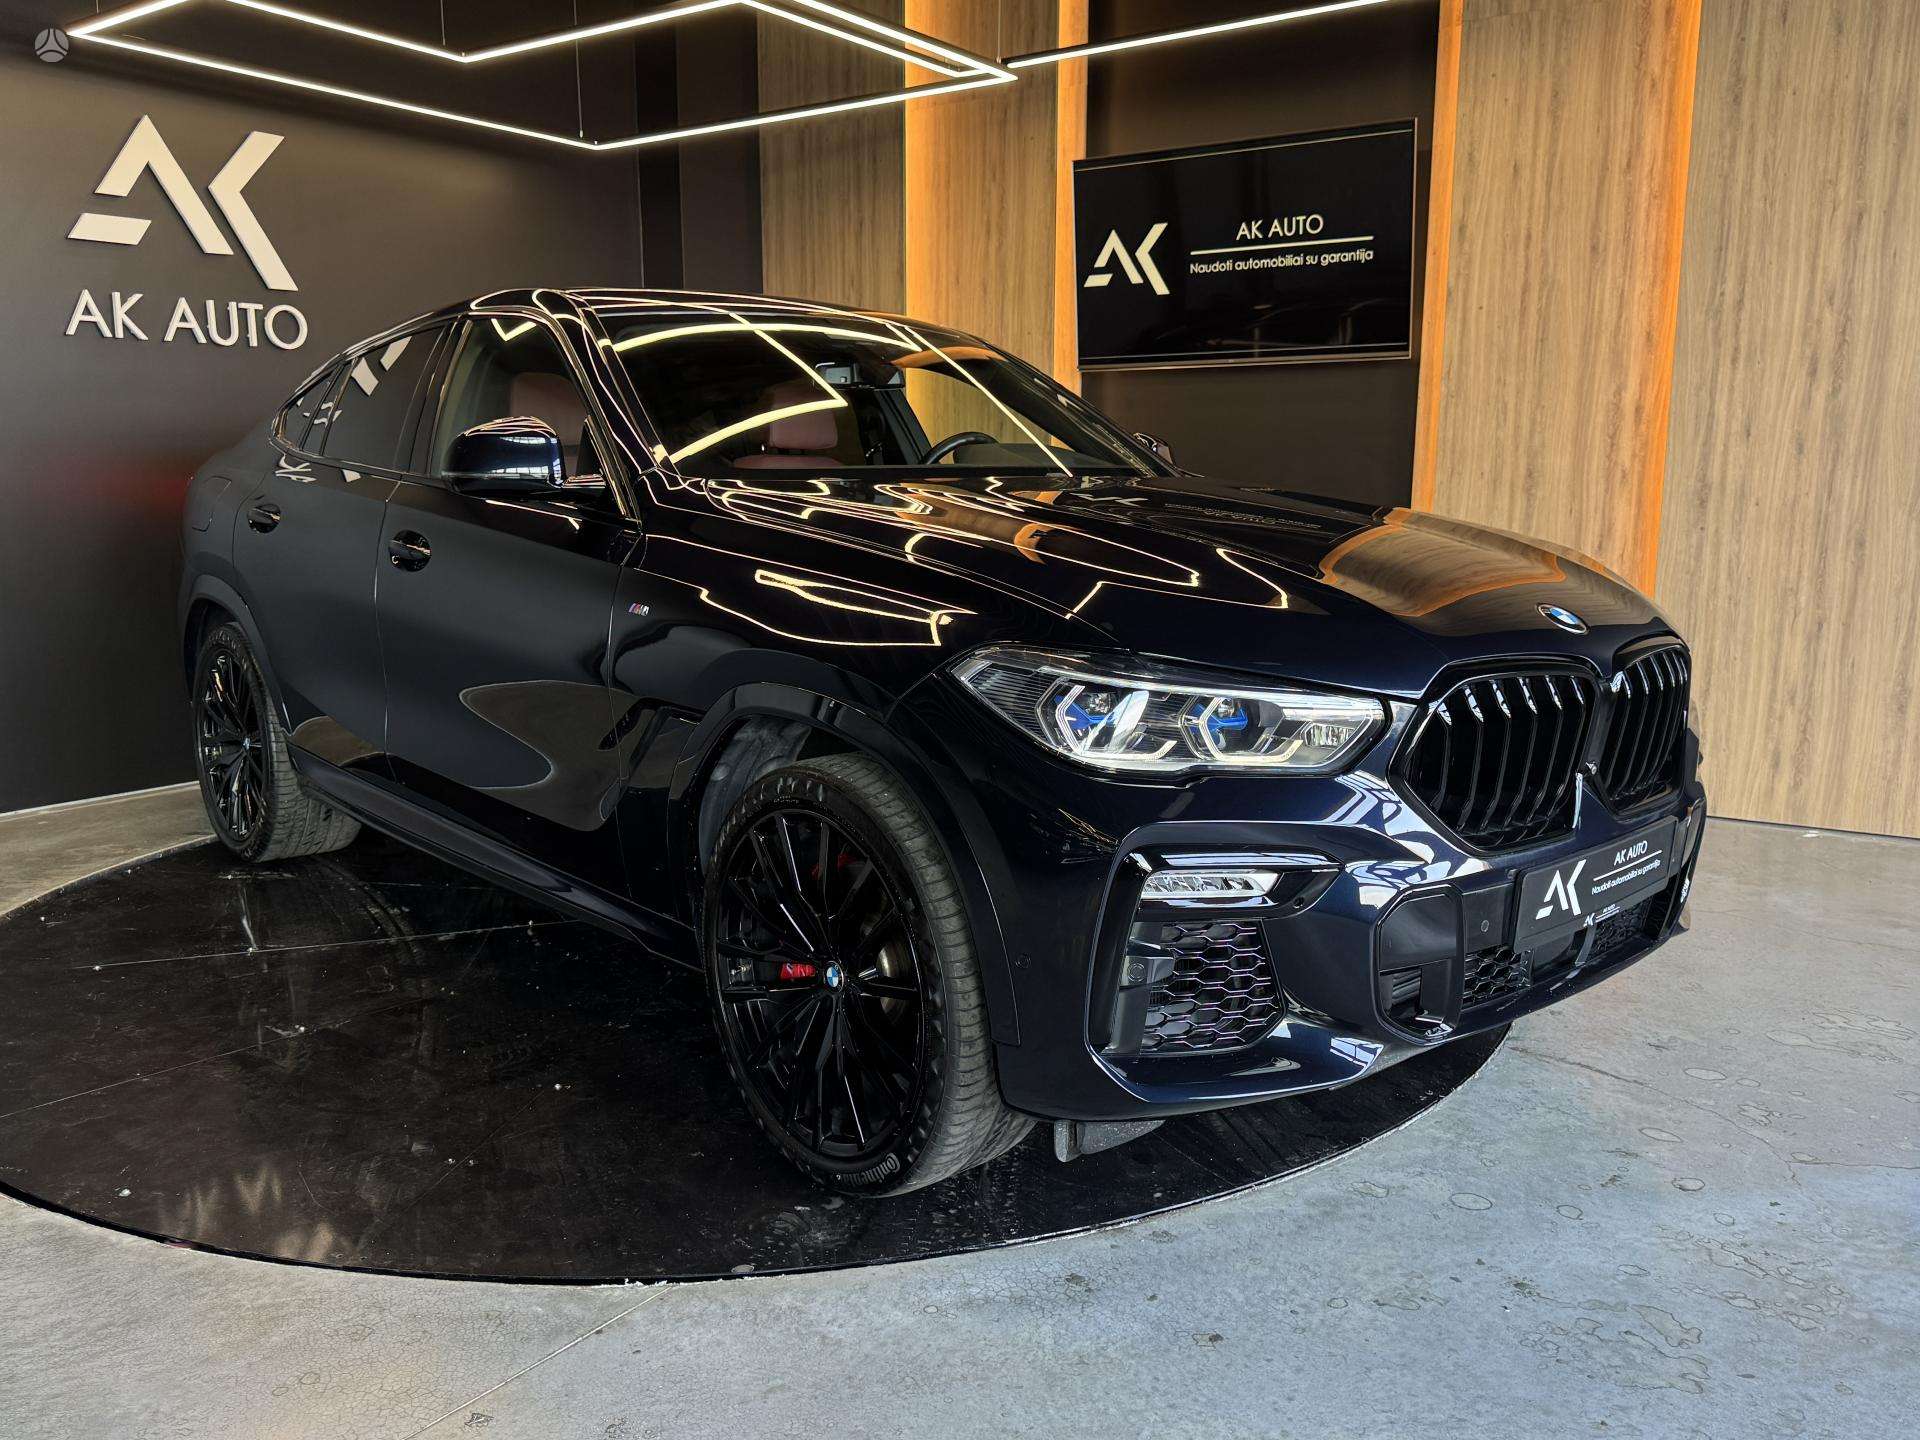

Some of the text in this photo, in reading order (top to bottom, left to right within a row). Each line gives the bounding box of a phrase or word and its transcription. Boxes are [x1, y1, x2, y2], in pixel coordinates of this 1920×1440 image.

[67, 114, 299, 291] AK
[1236, 213, 1324, 241] AK AUTO
[1083, 222, 1170, 295] AK
[1190, 248, 1374, 274] Naudoti automobiliai su garantija
[65, 288, 308, 350] AK AUTO
[1613, 840, 1648, 866] AK AUTO
[1535, 859, 1587, 920] AK
